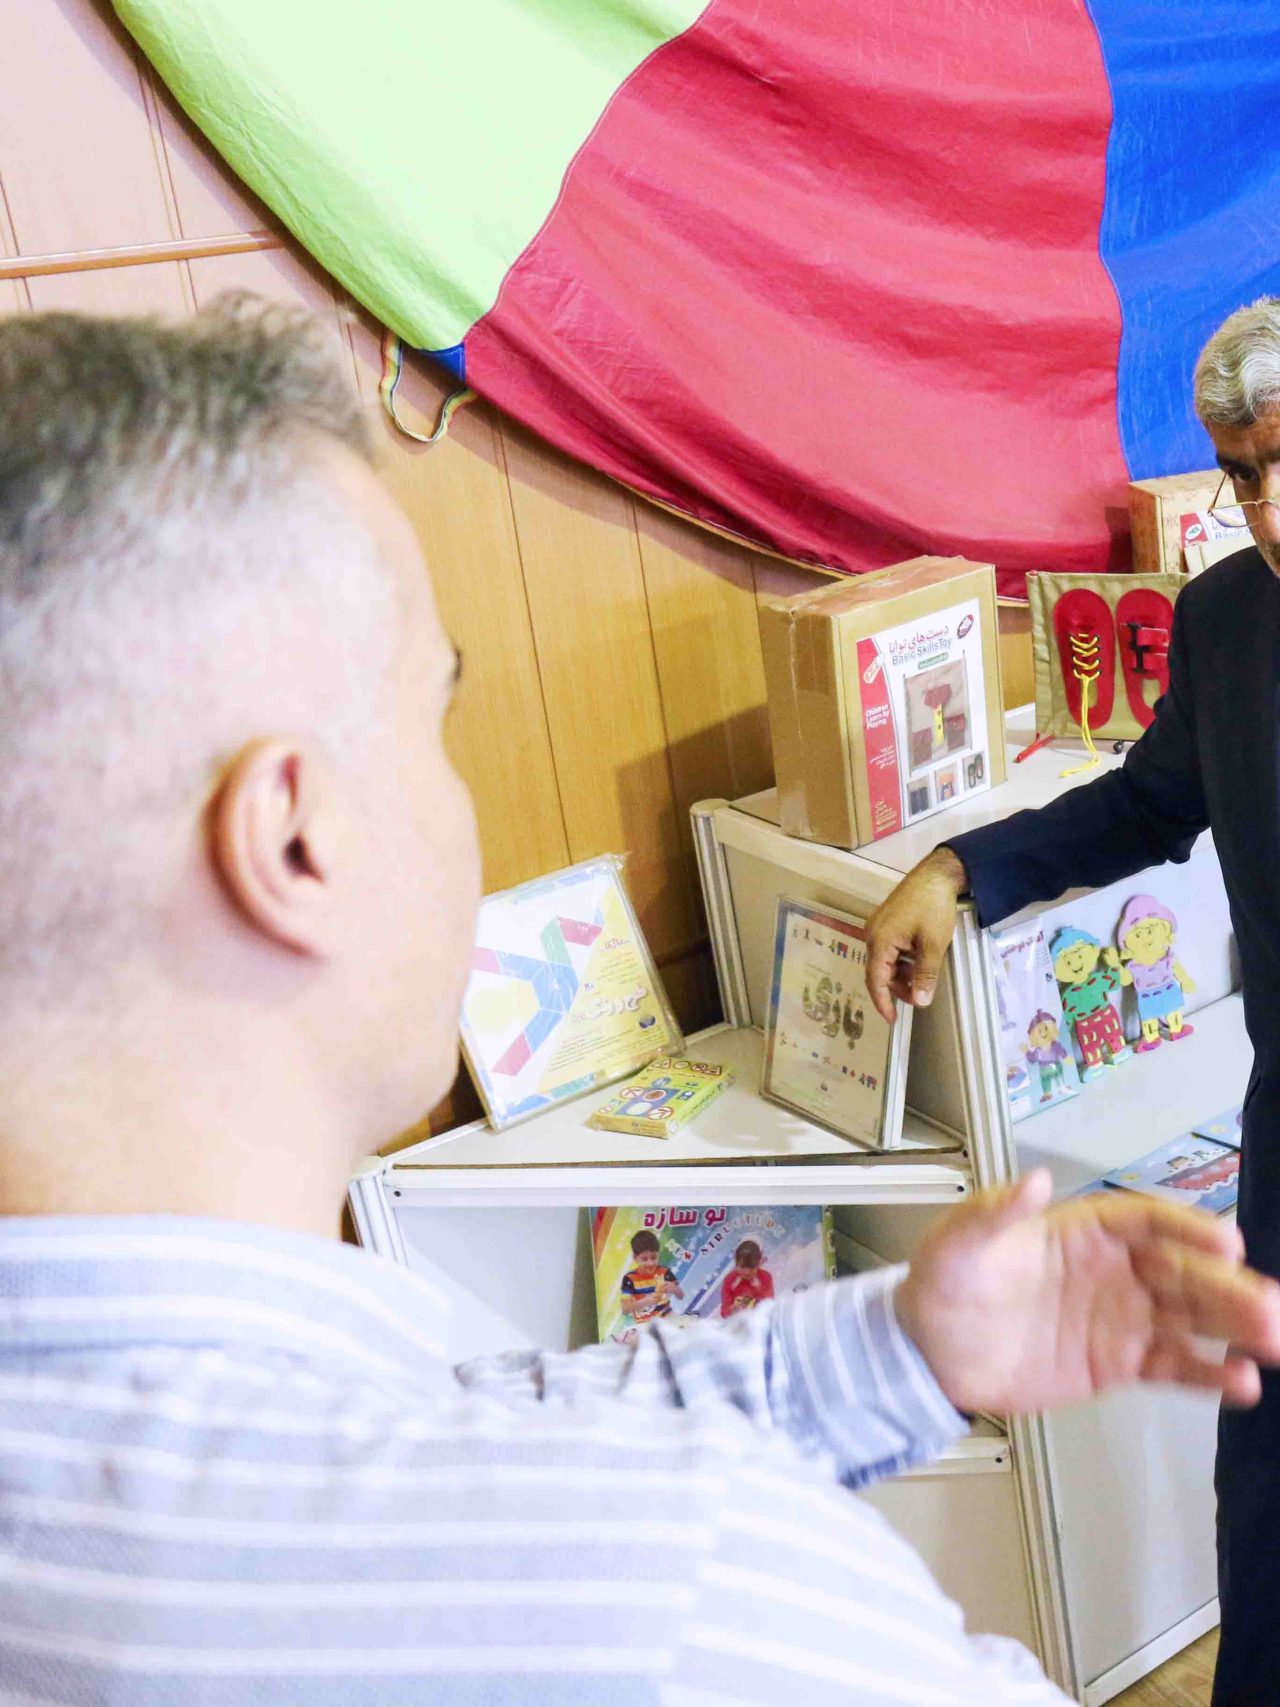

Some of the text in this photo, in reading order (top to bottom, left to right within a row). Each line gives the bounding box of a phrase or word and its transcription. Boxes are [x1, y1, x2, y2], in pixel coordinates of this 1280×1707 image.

[891, 651, 918, 666] Basic
[917, 642, 939, 657] Skills
[643, 1206, 698, 1230] سازه
